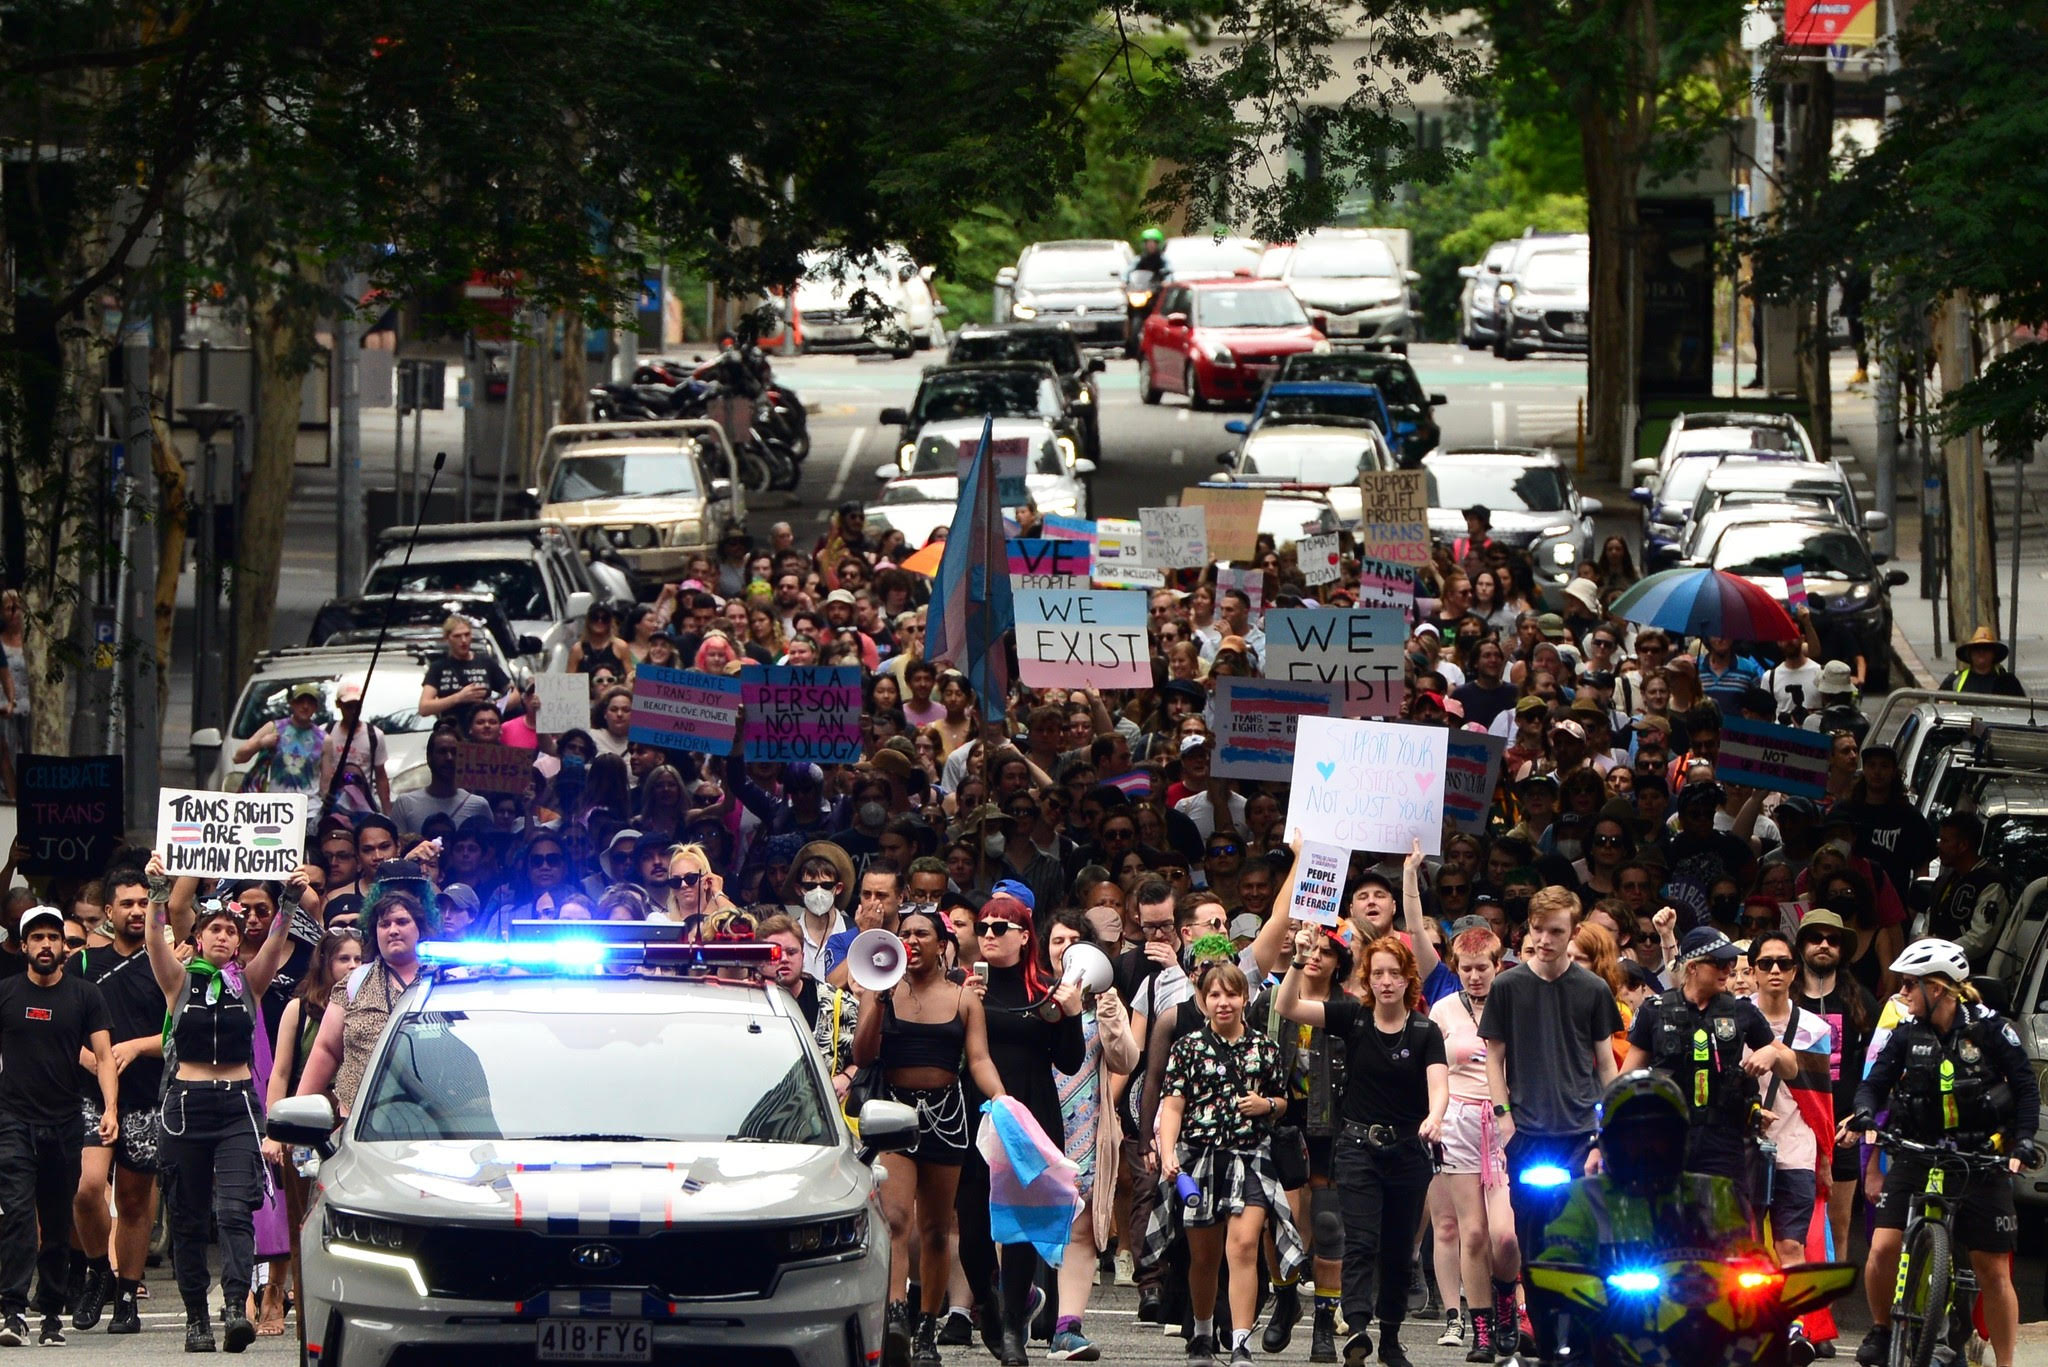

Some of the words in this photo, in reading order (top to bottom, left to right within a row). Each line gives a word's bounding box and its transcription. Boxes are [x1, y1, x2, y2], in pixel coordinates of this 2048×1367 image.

[1364, 473, 1421, 492] SUPPORT
[1371, 491, 1414, 508] UPLIFT
[1367, 507, 1424, 523] PROTECT
[1302, 533, 1338, 551] TOMATO
[1369, 523, 1425, 542] TRANS
[1125, 545, 1137, 556] IS
[1368, 542, 1428, 563] VOICES
[1304, 567, 1337, 584] TODAY
[1365, 560, 1413, 584] TRANS
[1039, 596, 1096, 623] WE
[1365, 598, 1410, 616] BEAY
[99, 624, 112, 641] P
[1287, 615, 1374, 653] WE
[1037, 630, 1141, 673] EXIST
[656, 669, 726, 691] CELEBRATE
[762, 668, 770, 686] I
[789, 668, 815, 687] AM
[829, 668, 842, 688] A
[656, 684, 692, 702] TRANS
[699, 692, 722, 706] JOY
[759, 687, 849, 713] PERSON
[700, 709, 728, 722] POWER
[766, 713, 804, 735] NOT
[817, 714, 844, 734] AN
[1233, 714, 1263, 723] TRANS
[672, 720, 696, 733] AND
[1232, 723, 1264, 733] RIGHTS
[653, 733, 711, 752] EUPHORIA
[754, 735, 862, 759] IDEOLOGY
[1326, 724, 1392, 765] SUPPORT
[1399, 732, 1435, 769] YOUR
[1763, 749, 1788, 763] NOT
[26, 763, 110, 789] CELEBRATE
[464, 762, 519, 776] LIVES
[1347, 767, 1408, 796] SISTERS
[32, 802, 105, 825] TRANS
[169, 794, 229, 823] TRANS
[234, 800, 294, 825] RIGHTS
[1306, 785, 1342, 814] NOT
[1346, 795, 1388, 817] JUST
[1399, 799, 1436, 824] YOUR
[203, 824, 242, 845] ARE
[1871, 828, 1902, 852] CULT
[36, 835, 96, 861] JOY
[166, 844, 230, 872] HUMAN
[234, 847, 298, 873] RIGHTS
[1306, 868, 1336, 883] PEOPLE
[1300, 881, 1320, 894] WILL
[1320, 885, 1338, 898] NOT
[1295, 894, 1304, 906] BE
[1306, 898, 1336, 912] ERASED
[1950, 883, 1977, 920] C
